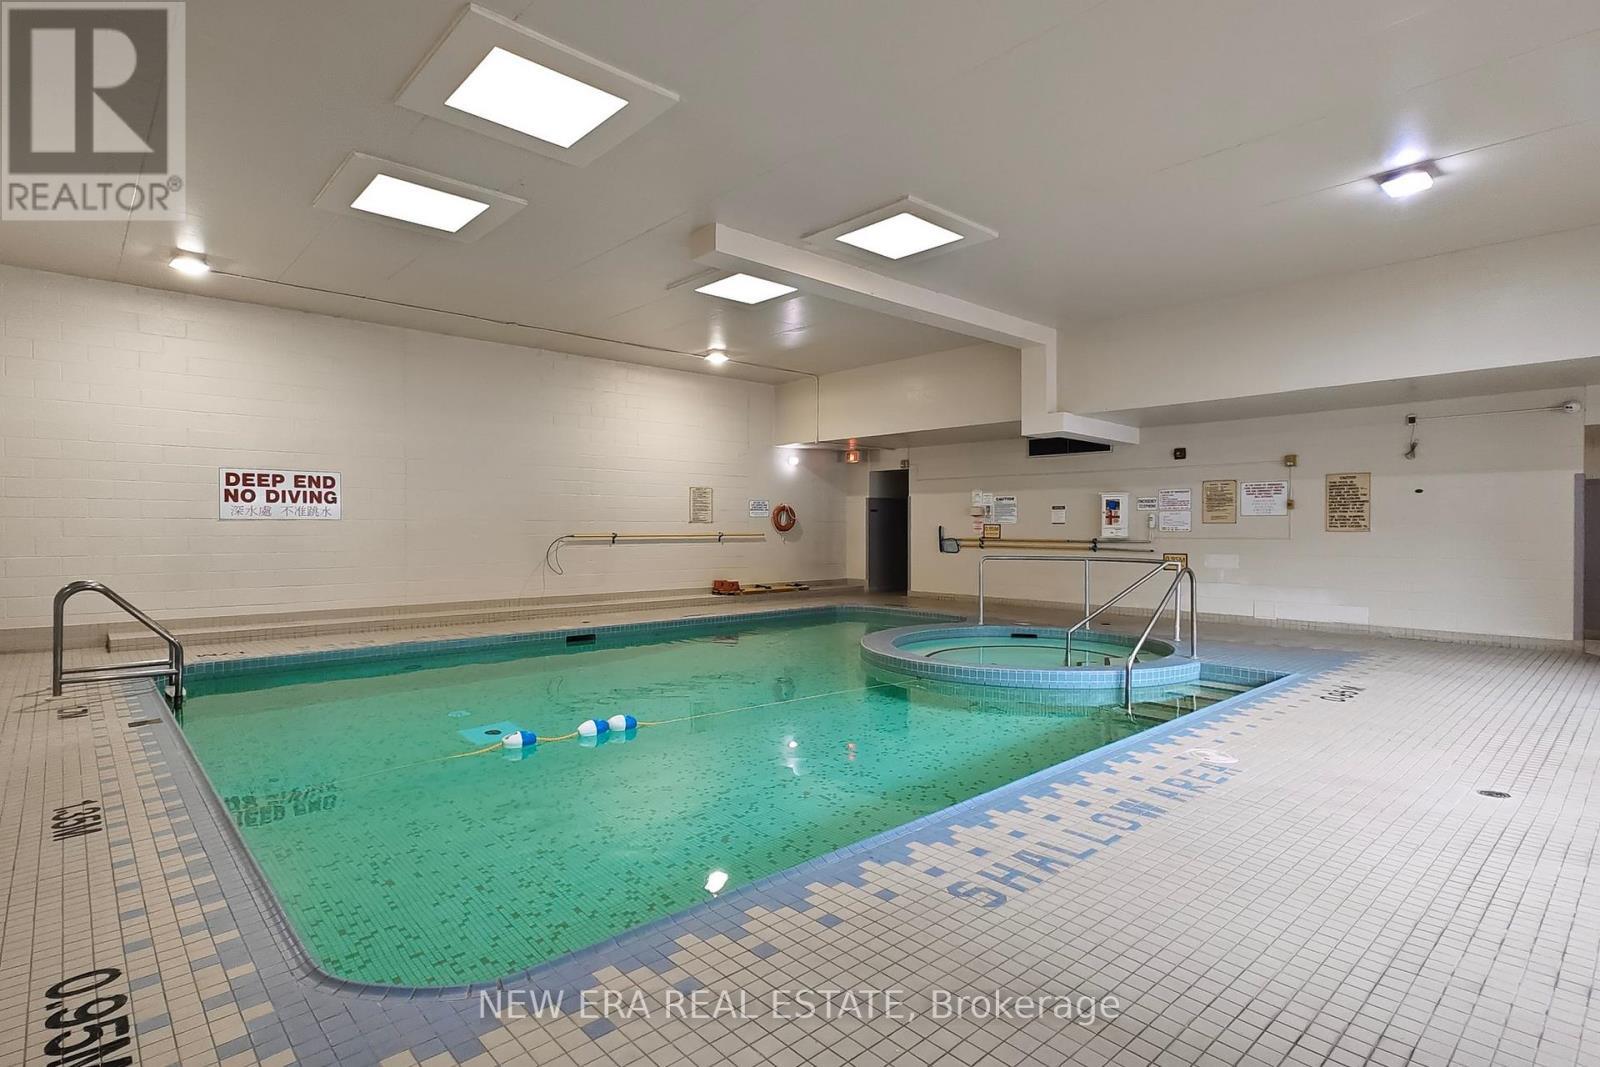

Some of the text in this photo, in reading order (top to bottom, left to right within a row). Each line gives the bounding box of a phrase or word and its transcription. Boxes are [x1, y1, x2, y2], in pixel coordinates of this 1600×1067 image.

[224, 471, 336, 489] DEEP END
[223, 487, 338, 505] NO DIVING
[945, 761, 1243, 909] SHALLOW AREA
